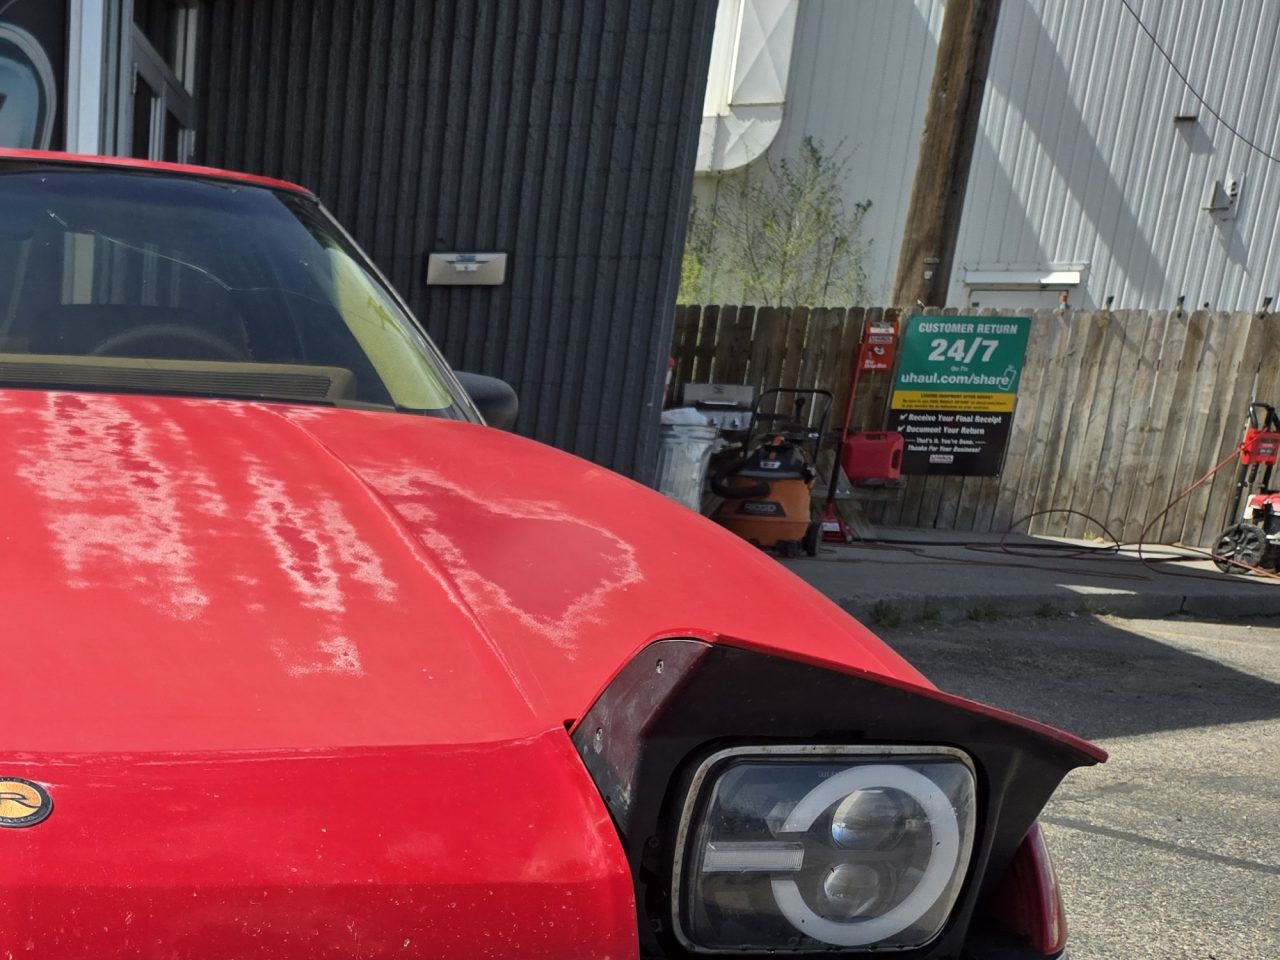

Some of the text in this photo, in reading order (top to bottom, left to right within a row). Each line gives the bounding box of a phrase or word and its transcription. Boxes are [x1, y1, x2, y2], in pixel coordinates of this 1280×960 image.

[918, 322, 1018, 334] CUSTOMER RETURN
[928, 337, 999, 363] 24/7
[901, 372, 1009, 385] uhaul.com/share
[908, 414, 1002, 424] Receive Your Final Receipt
[906, 425, 985, 435] Document Your Return
